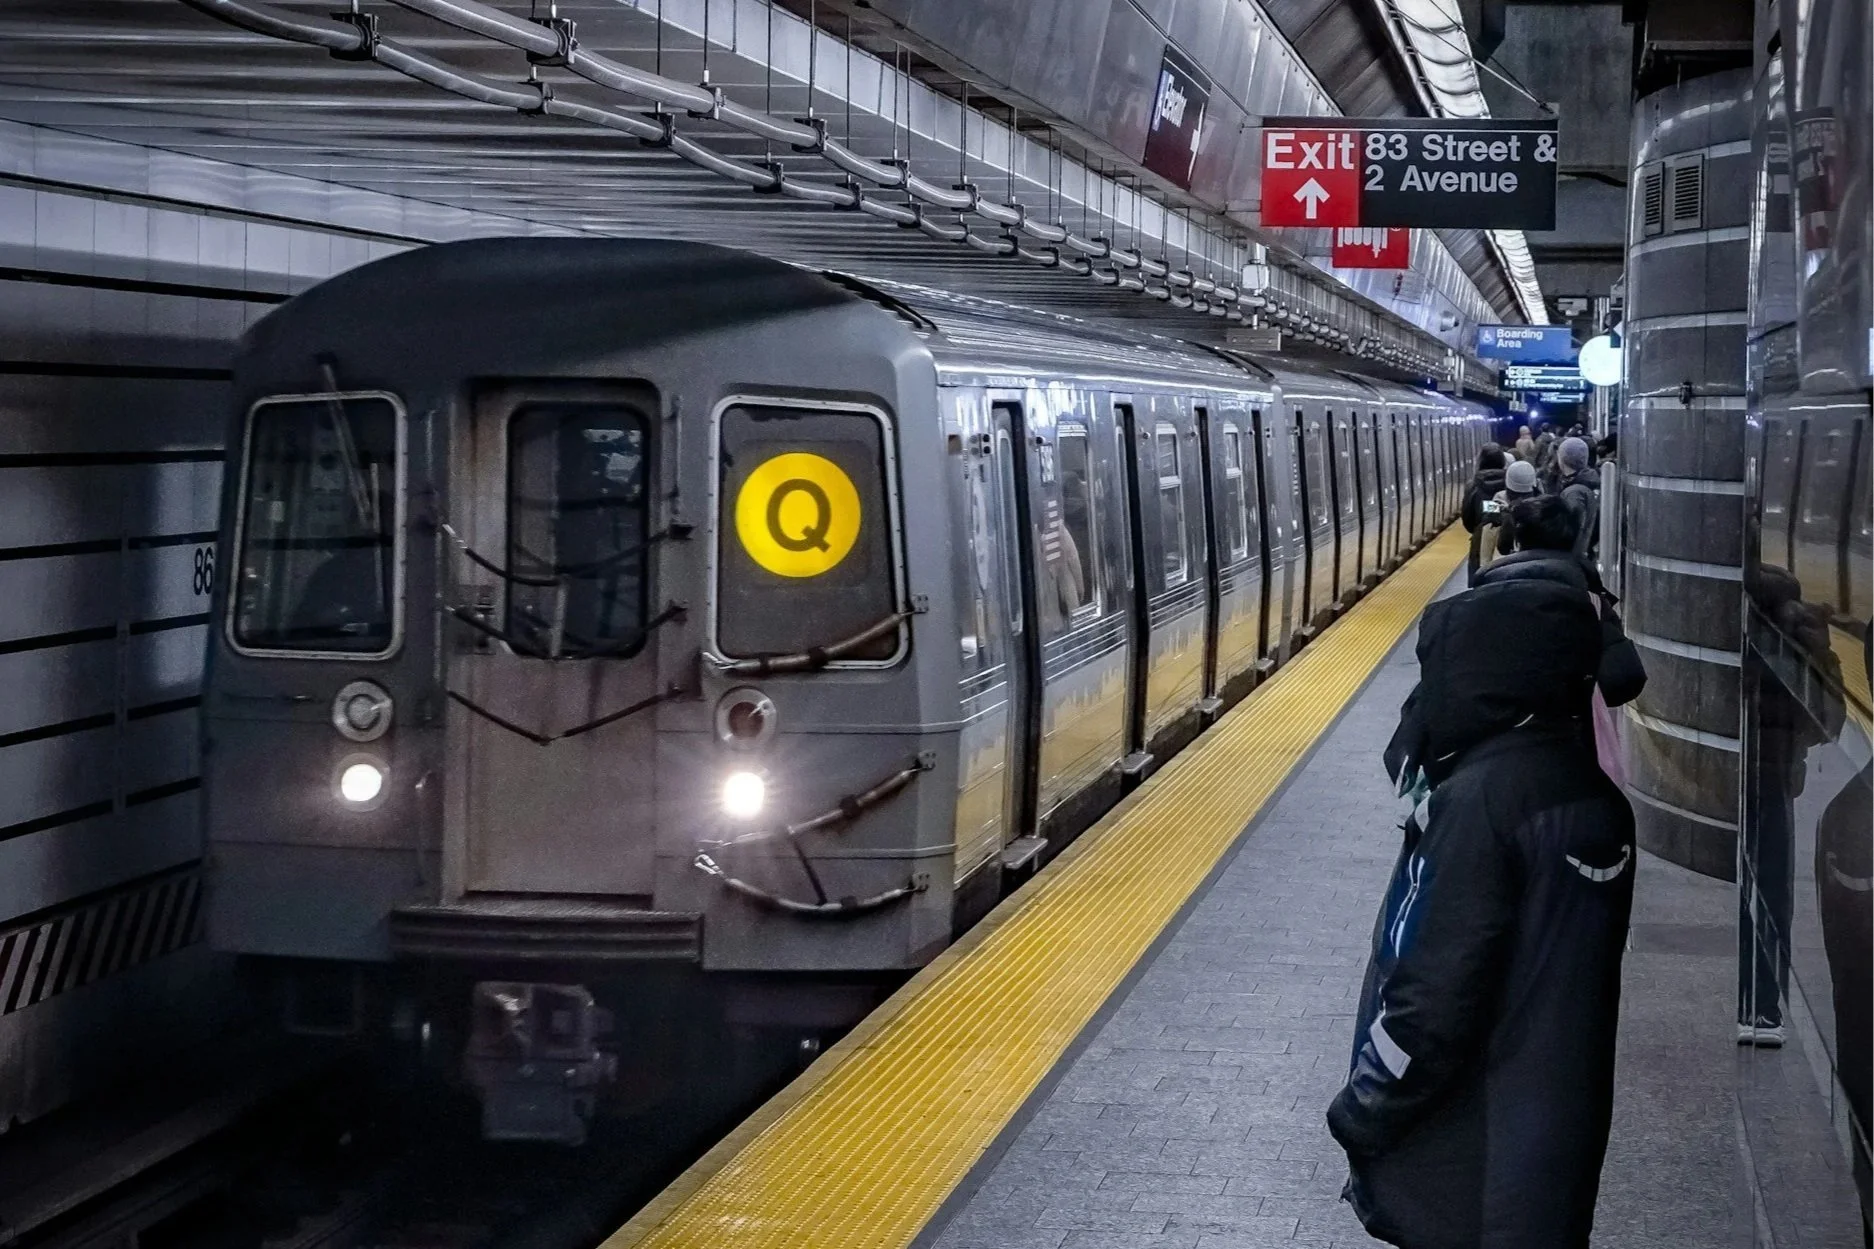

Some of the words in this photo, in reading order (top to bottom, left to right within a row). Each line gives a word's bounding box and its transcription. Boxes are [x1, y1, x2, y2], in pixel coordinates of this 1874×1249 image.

[1266, 132, 1355, 170] Exit
[1365, 132, 1408, 161] 83
[1422, 133, 1521, 162] Street
[1533, 134, 1557, 163] &
[1364, 165, 1385, 192] 2
[1400, 165, 1518, 193] Avenue
[1496, 328, 1544, 341] Boarding
[1496, 339, 1523, 348] Area
[766, 478, 832, 553] Q
[193, 547, 214, 595] 86
